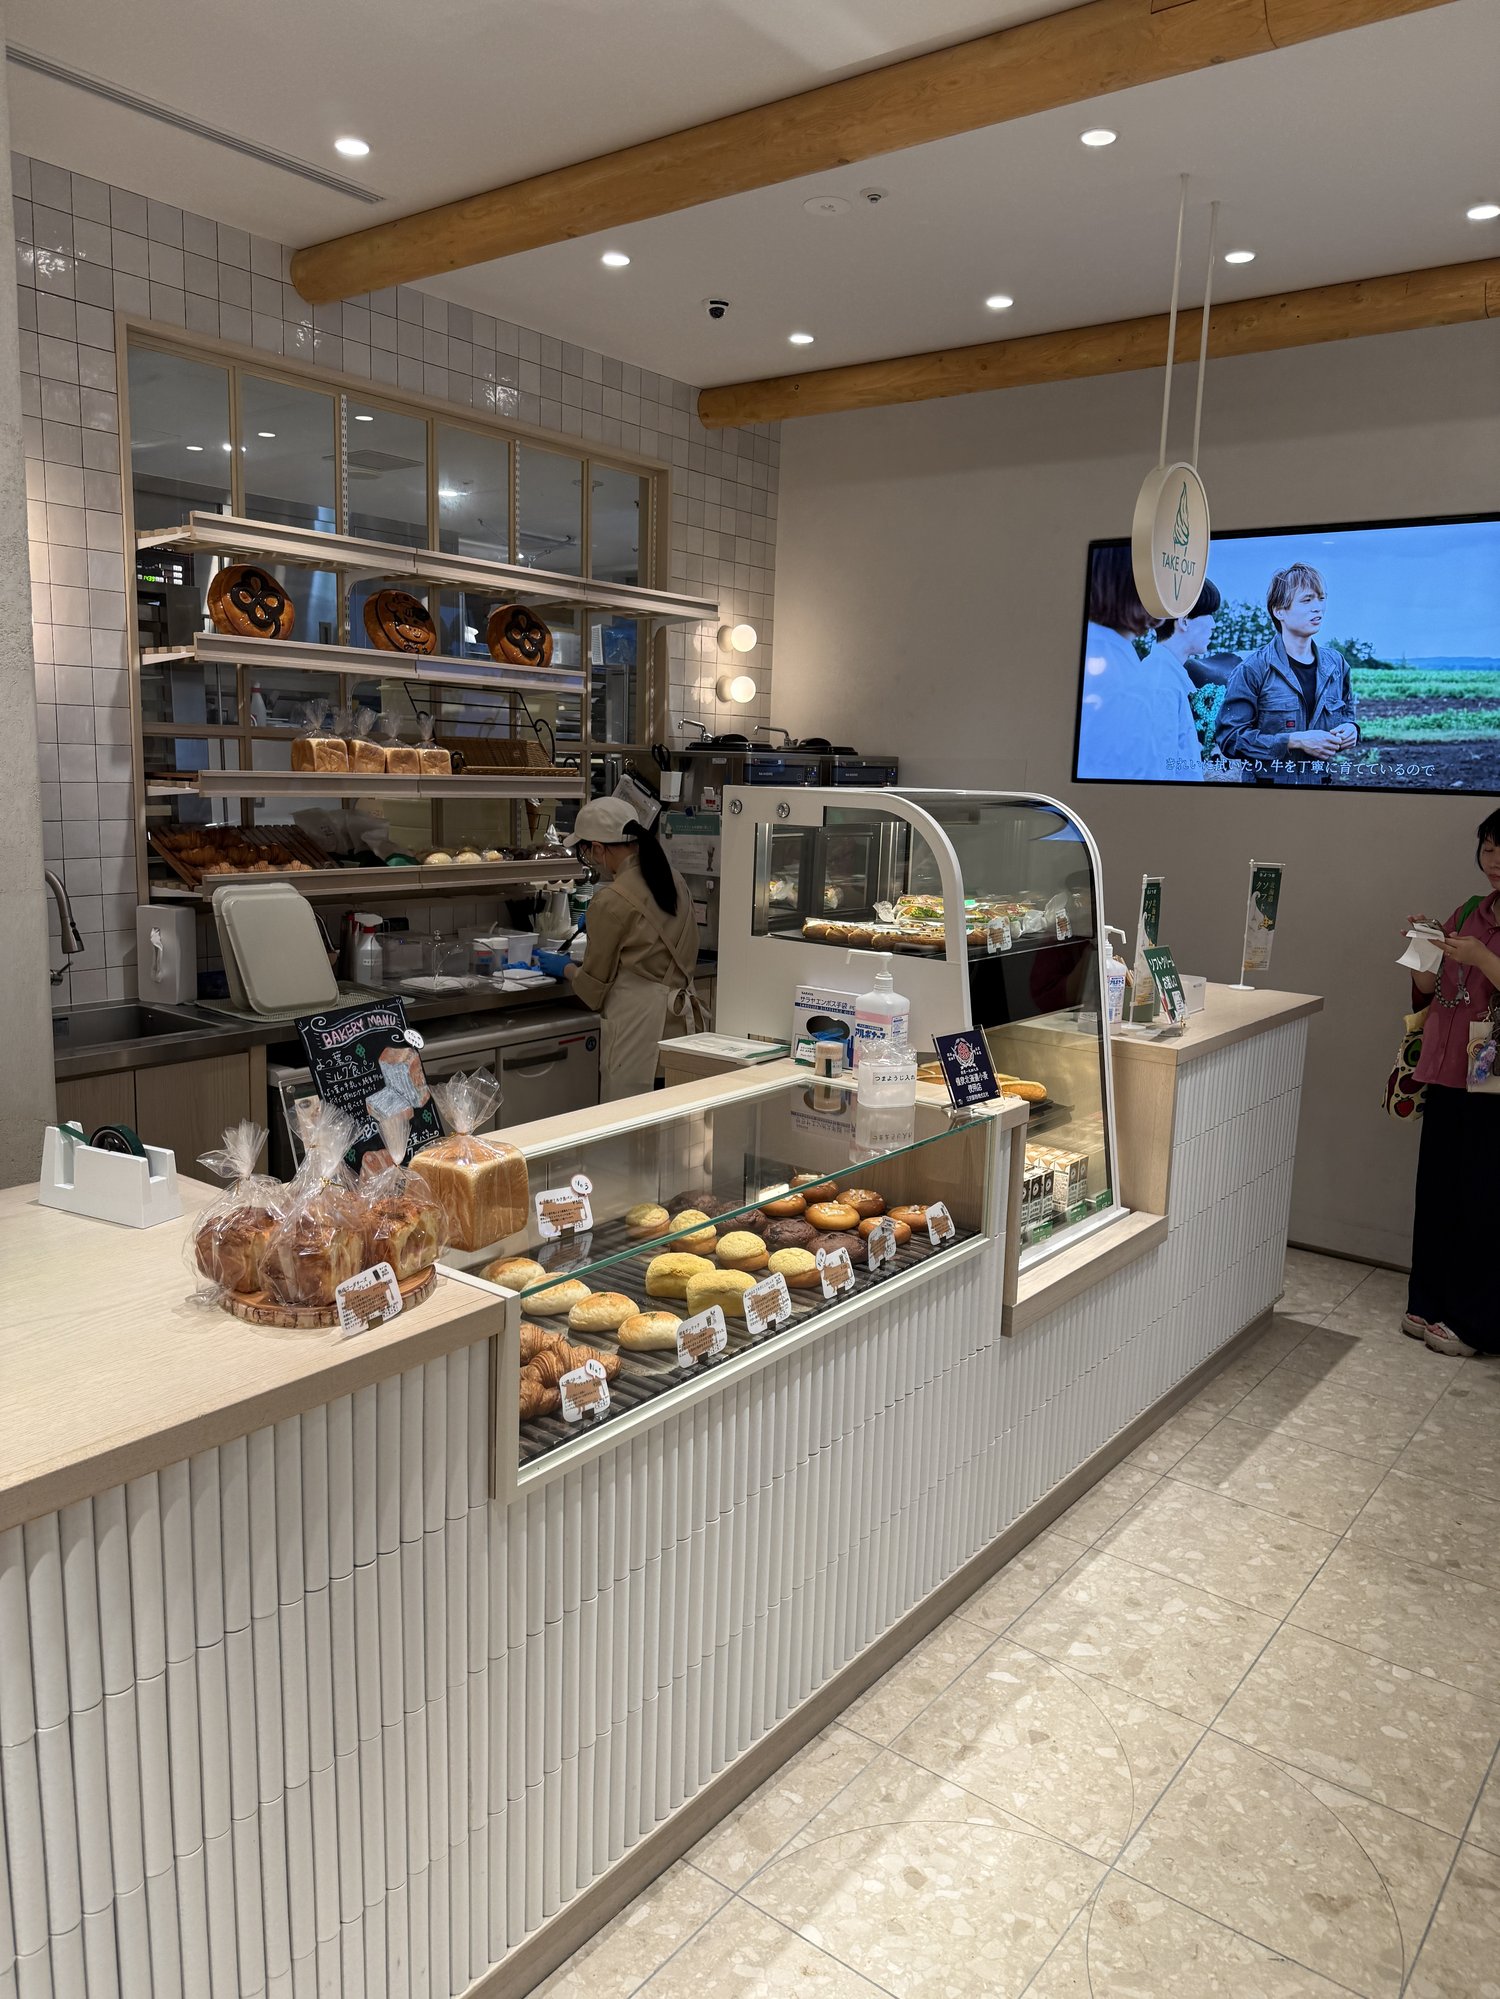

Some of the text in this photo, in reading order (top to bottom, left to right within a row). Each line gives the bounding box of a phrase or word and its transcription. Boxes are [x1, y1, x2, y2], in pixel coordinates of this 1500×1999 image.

[1162, 552, 1196, 576] TAKE OUT
[800, 996, 848, 1010] サラヤエンボス手袋
[321, 1015, 396, 1048] BAKERY MANU
[316, 1050, 353, 1071] よつ葉の
[325, 1060, 376, 1083] ミルク食パン
